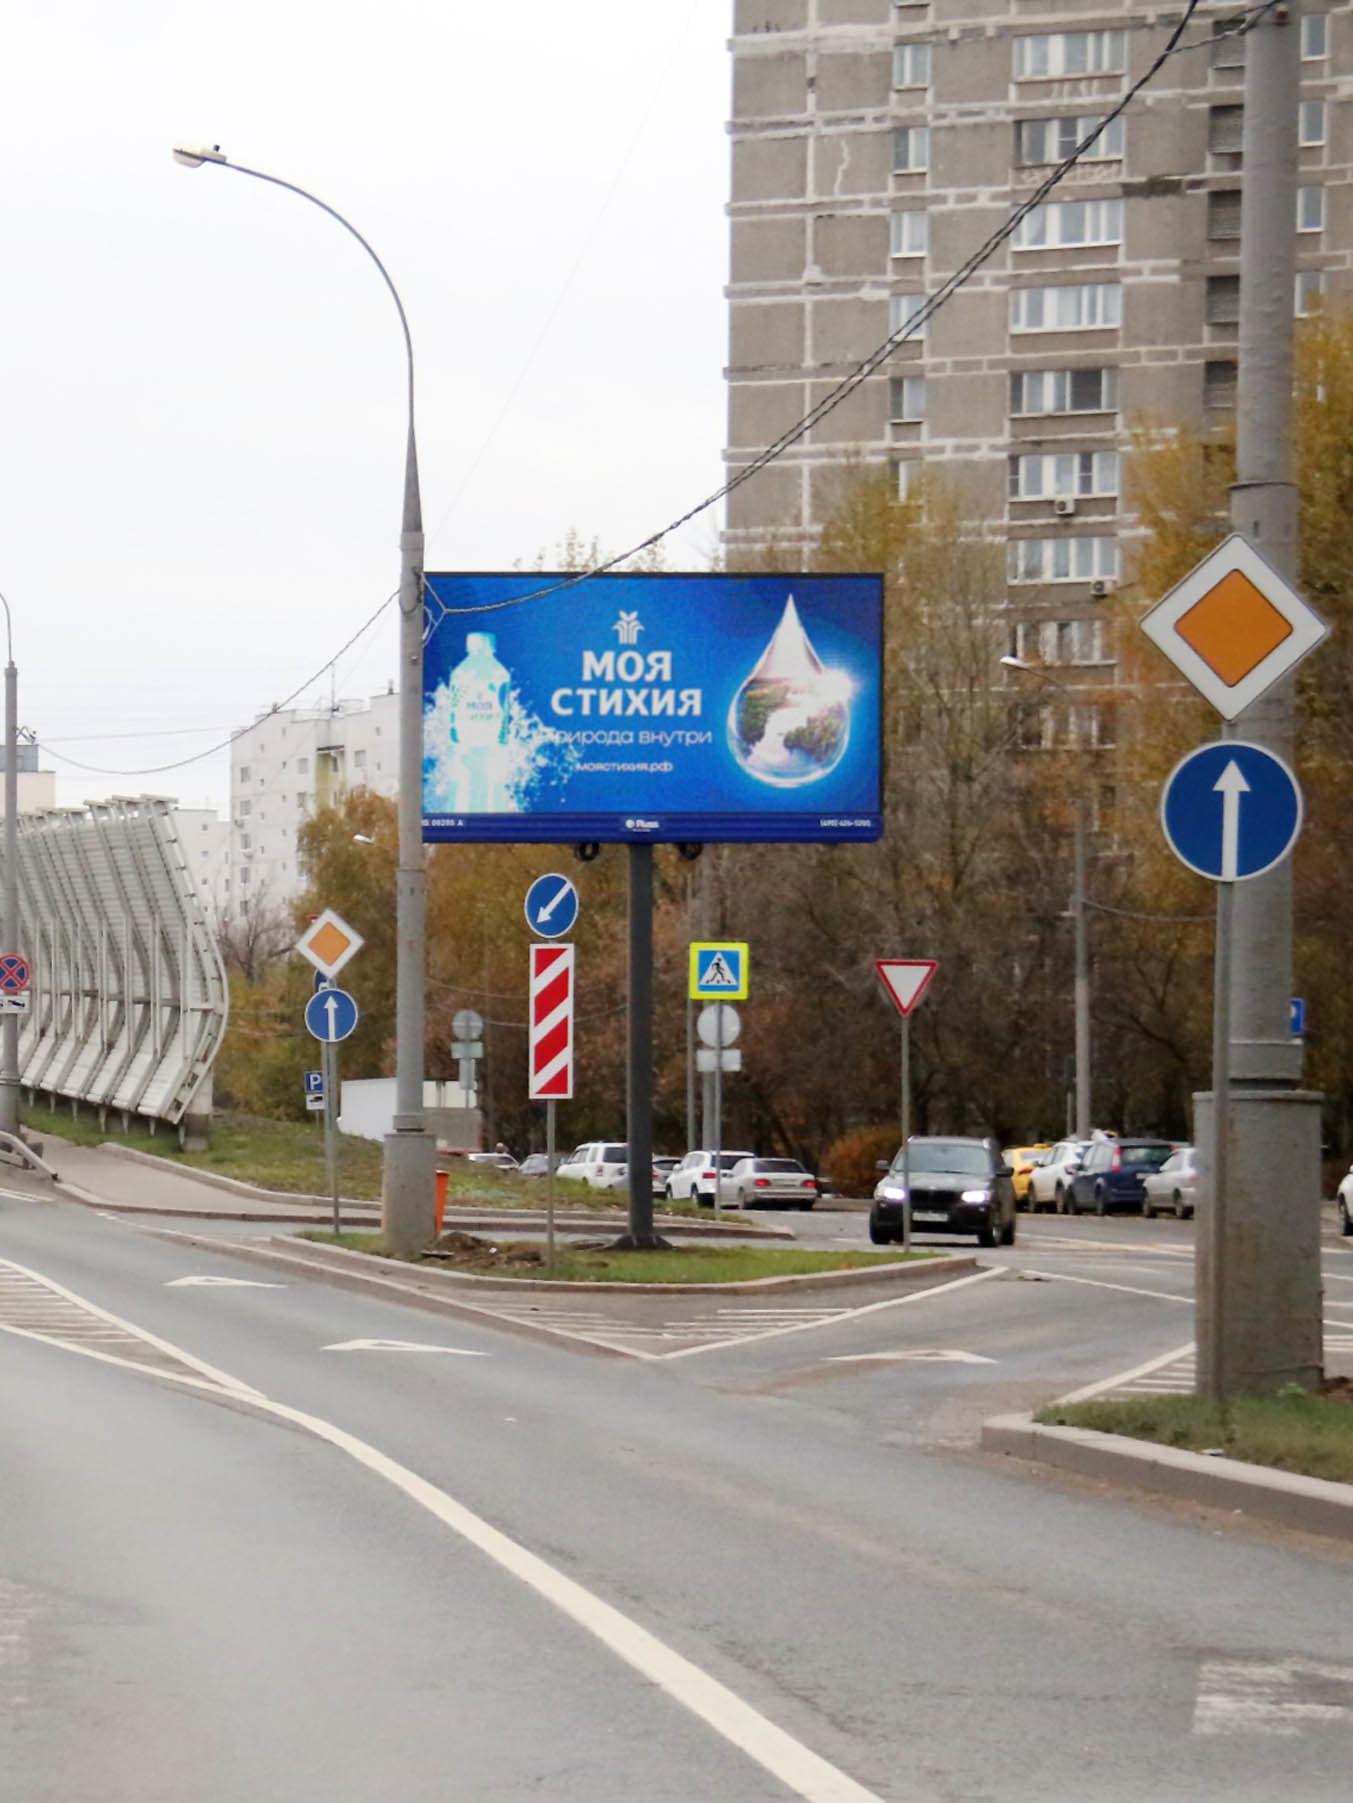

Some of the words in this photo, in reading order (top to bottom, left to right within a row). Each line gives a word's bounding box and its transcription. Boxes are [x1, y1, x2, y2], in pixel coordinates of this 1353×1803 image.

[582, 650, 672, 682] МОЯ
[551, 688, 702, 716] СТИХИЯ
[544, 727, 634, 748] рирода
[638, 730, 713, 748] внутри
